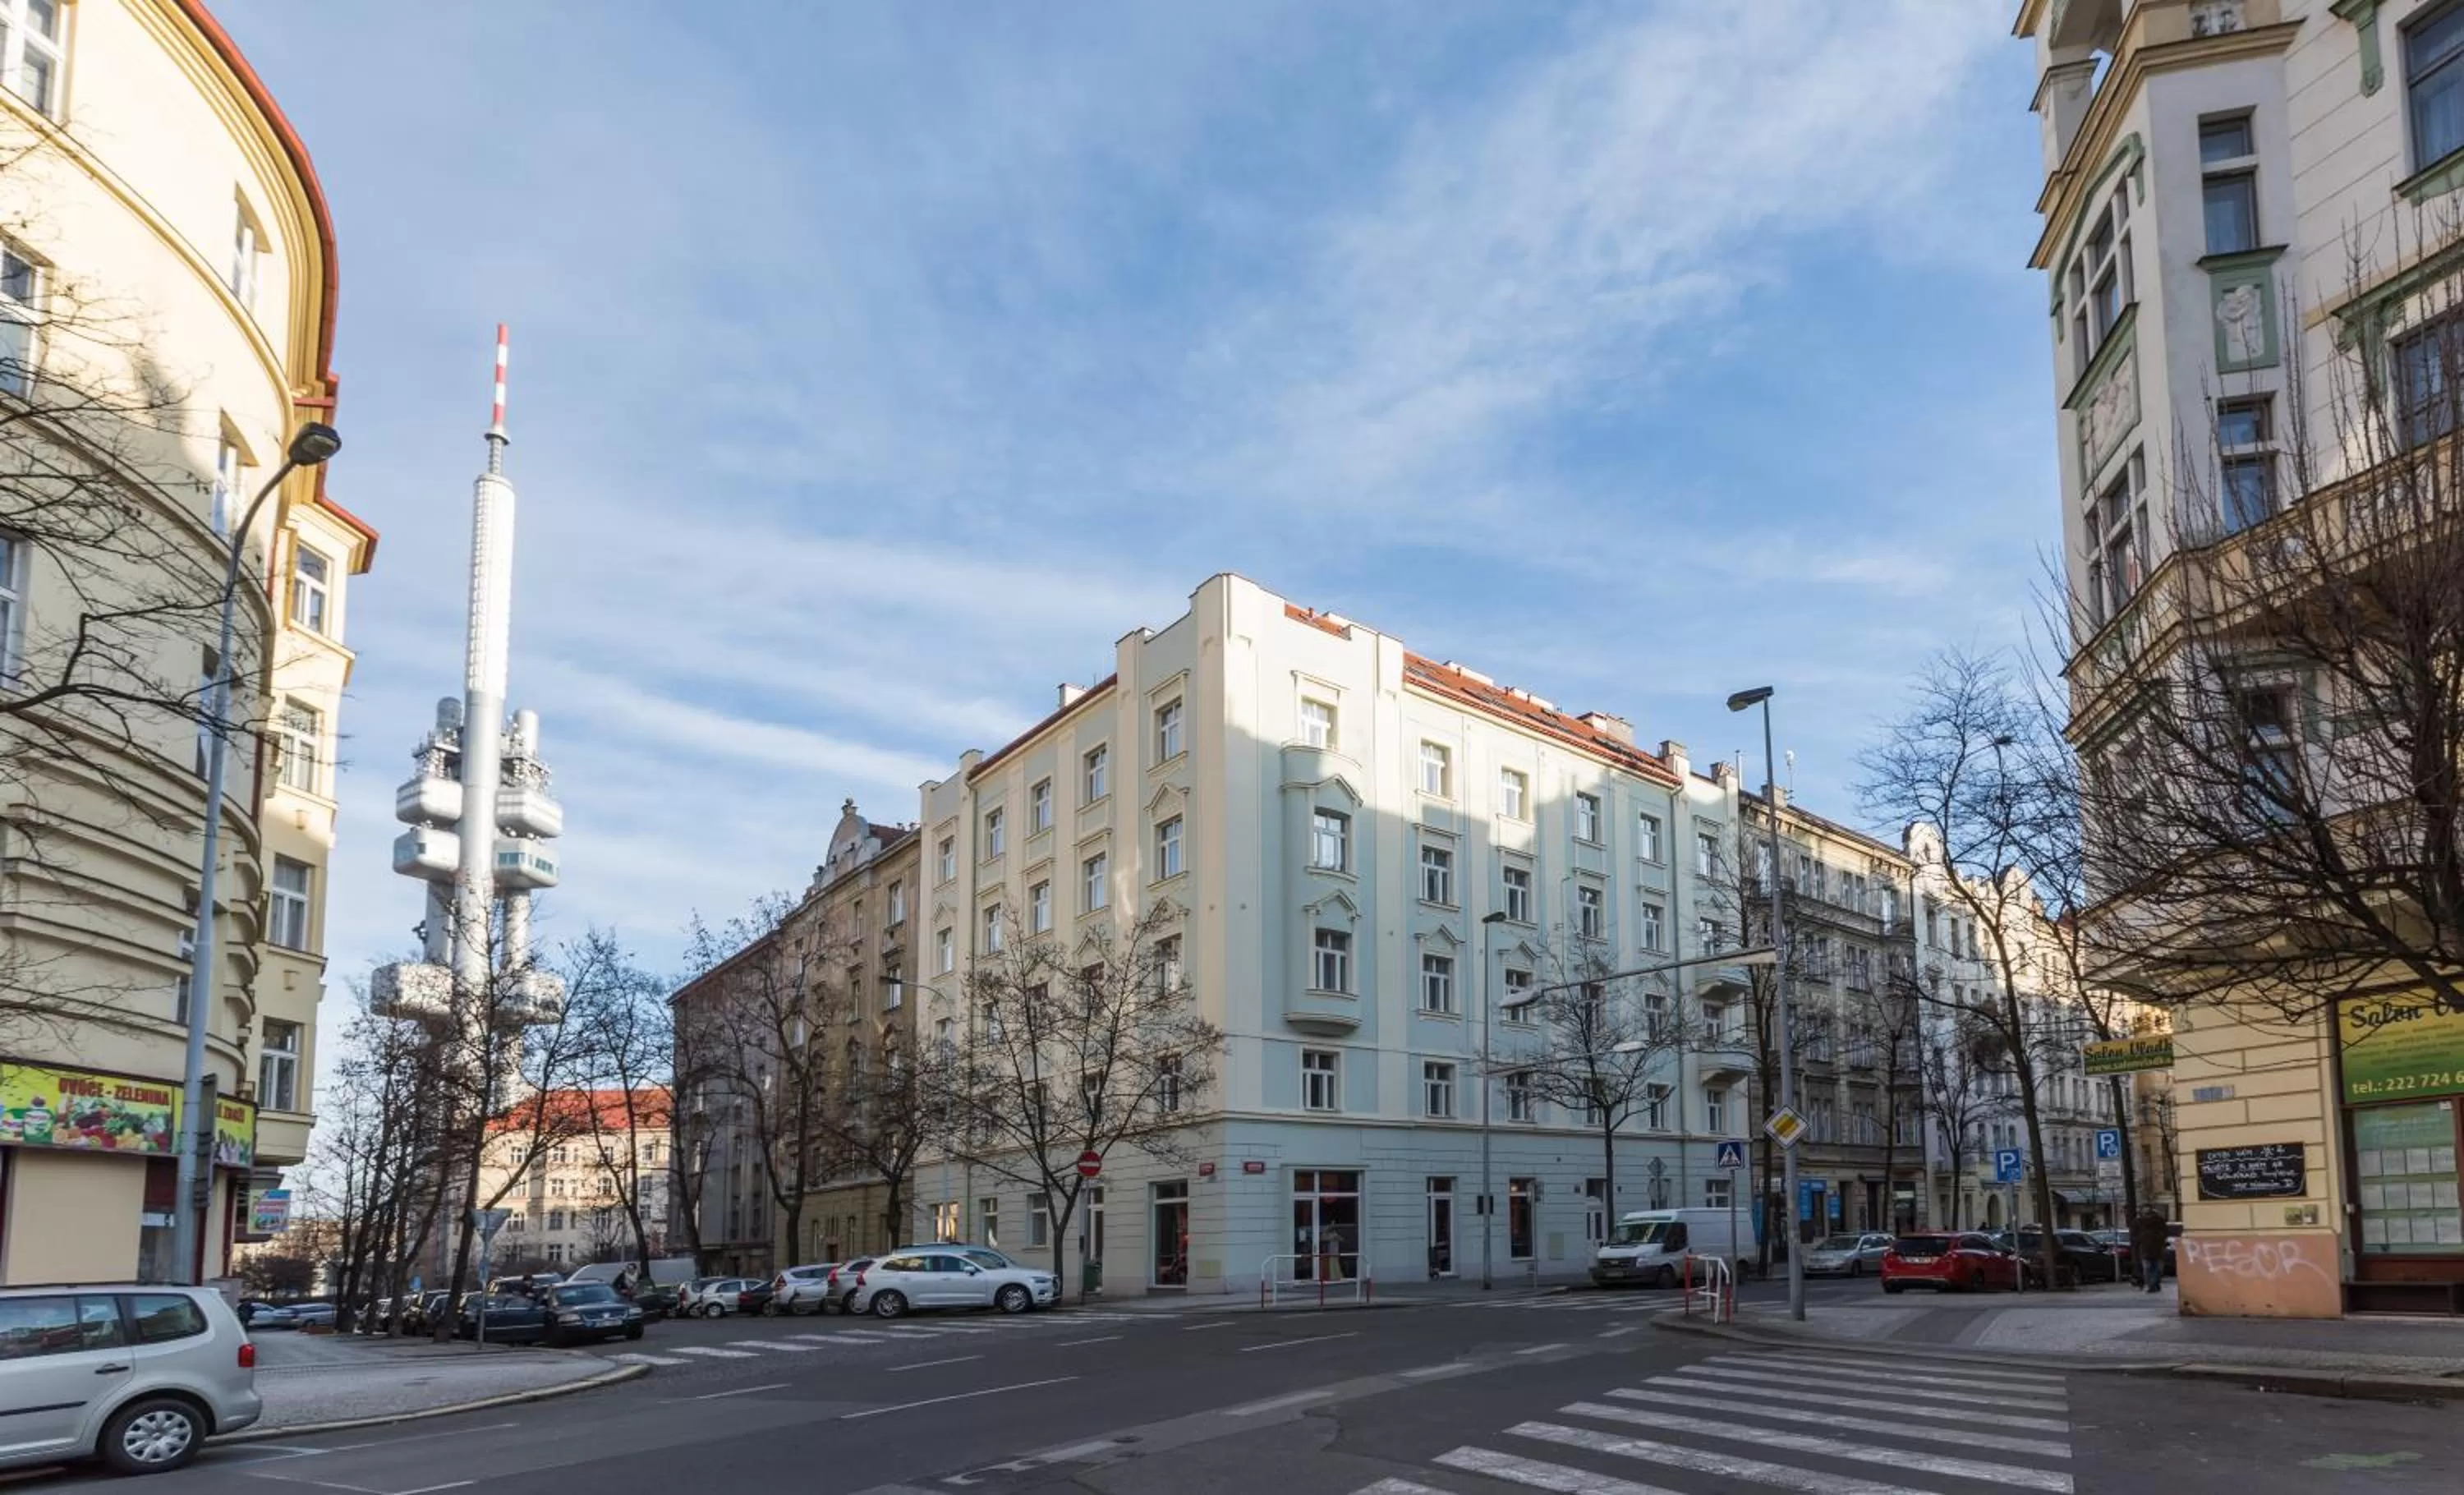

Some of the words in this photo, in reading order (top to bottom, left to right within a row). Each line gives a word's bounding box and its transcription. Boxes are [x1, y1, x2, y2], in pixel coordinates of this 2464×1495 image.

[2350, 1001, 2422, 1028] Salon
[2084, 1045, 2123, 1060] Salon
[2351, 1079, 2383, 1095] tel.:
[2385, 1075, 2416, 1092] 222
[2420, 1072, 2450, 1088] 724
[114, 1084, 169, 1106] ZELENINA
[2100, 1133, 2115, 1151] P
[2000, 1152, 2016, 1172] P
